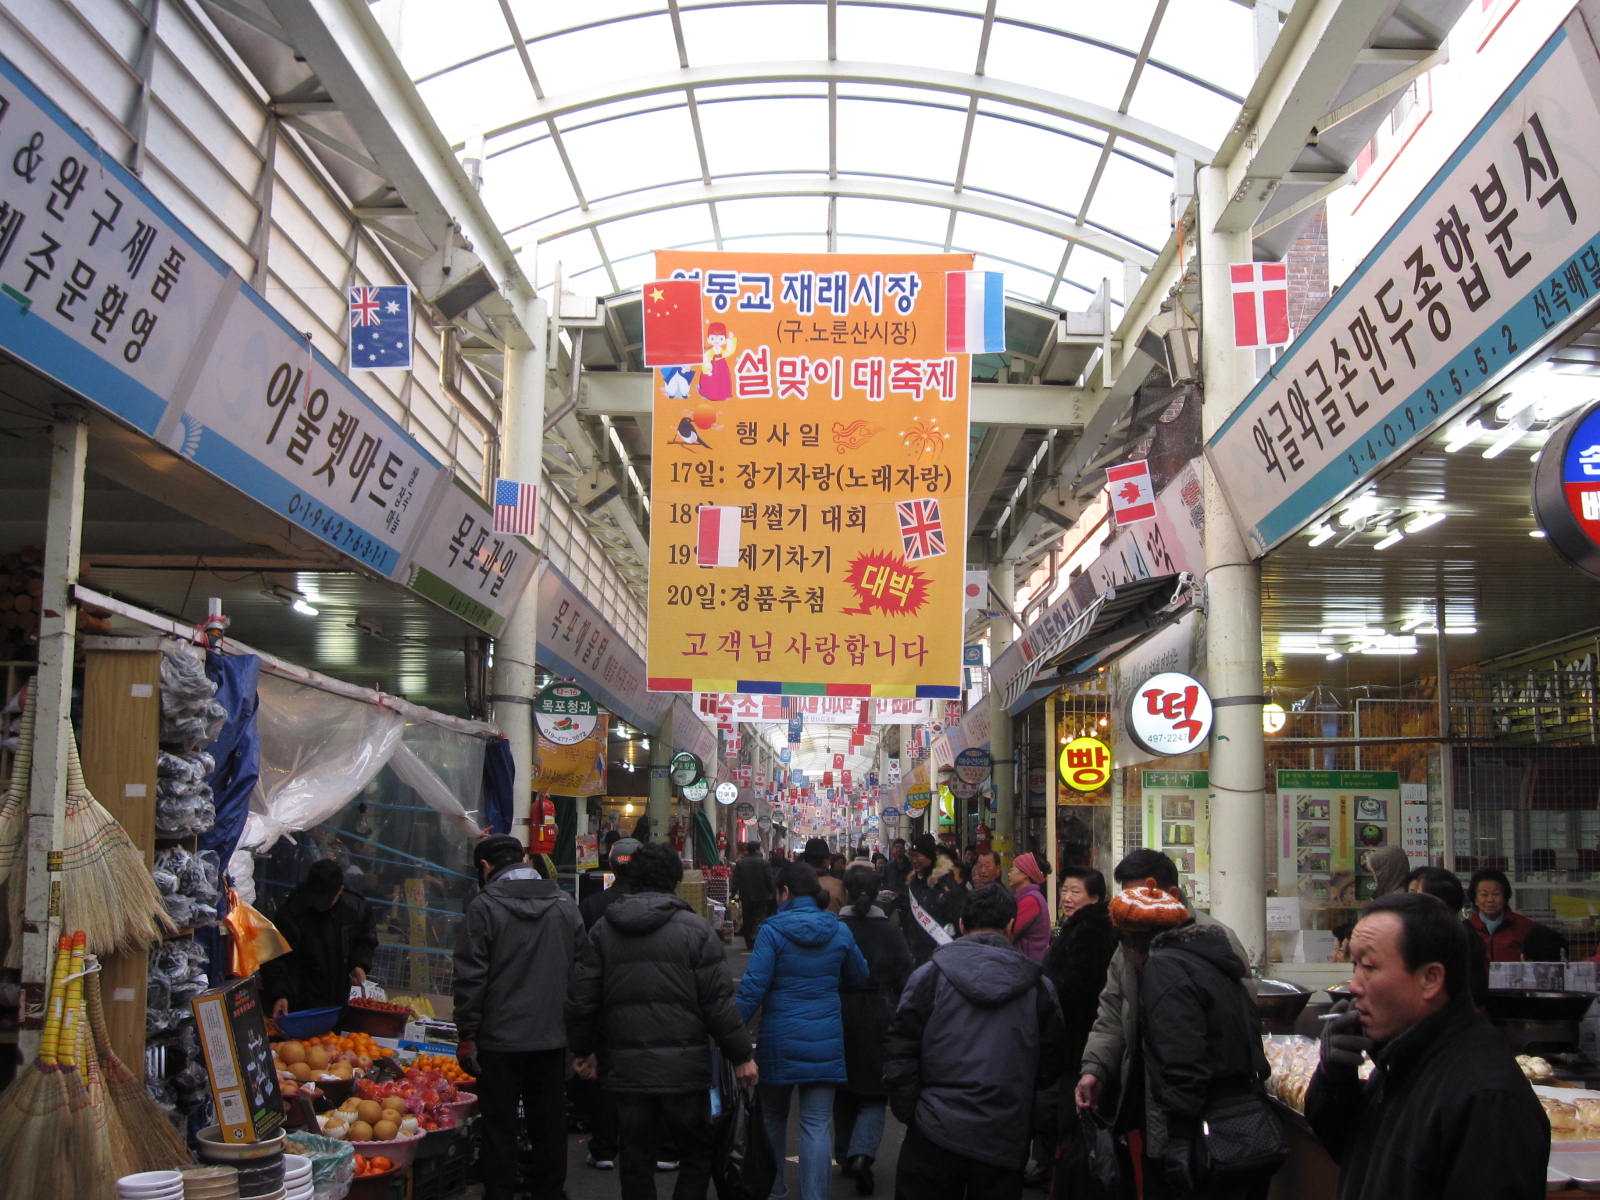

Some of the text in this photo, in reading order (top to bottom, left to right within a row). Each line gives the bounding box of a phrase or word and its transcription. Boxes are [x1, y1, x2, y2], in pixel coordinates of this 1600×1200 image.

[13, 132, 44, 183] &
[673, 271, 919, 313] 동교 재래시장
[854, 358, 955, 399] 대축제
[266, 362, 404, 509] 아울렛마트
[669, 459, 952, 493] 17일: 장기자랑(노래자랑)
[821, 504, 867, 533] 대회
[737, 543, 832, 574] 제기차기
[860, 564, 914, 607] 대박
[681, 629, 929, 667] 고객님 사랑합니다
[541, 699, 592, 715] 목포청과
[1141, 684, 1204, 744] 떡
[1067, 746, 1110, 785] 빵
